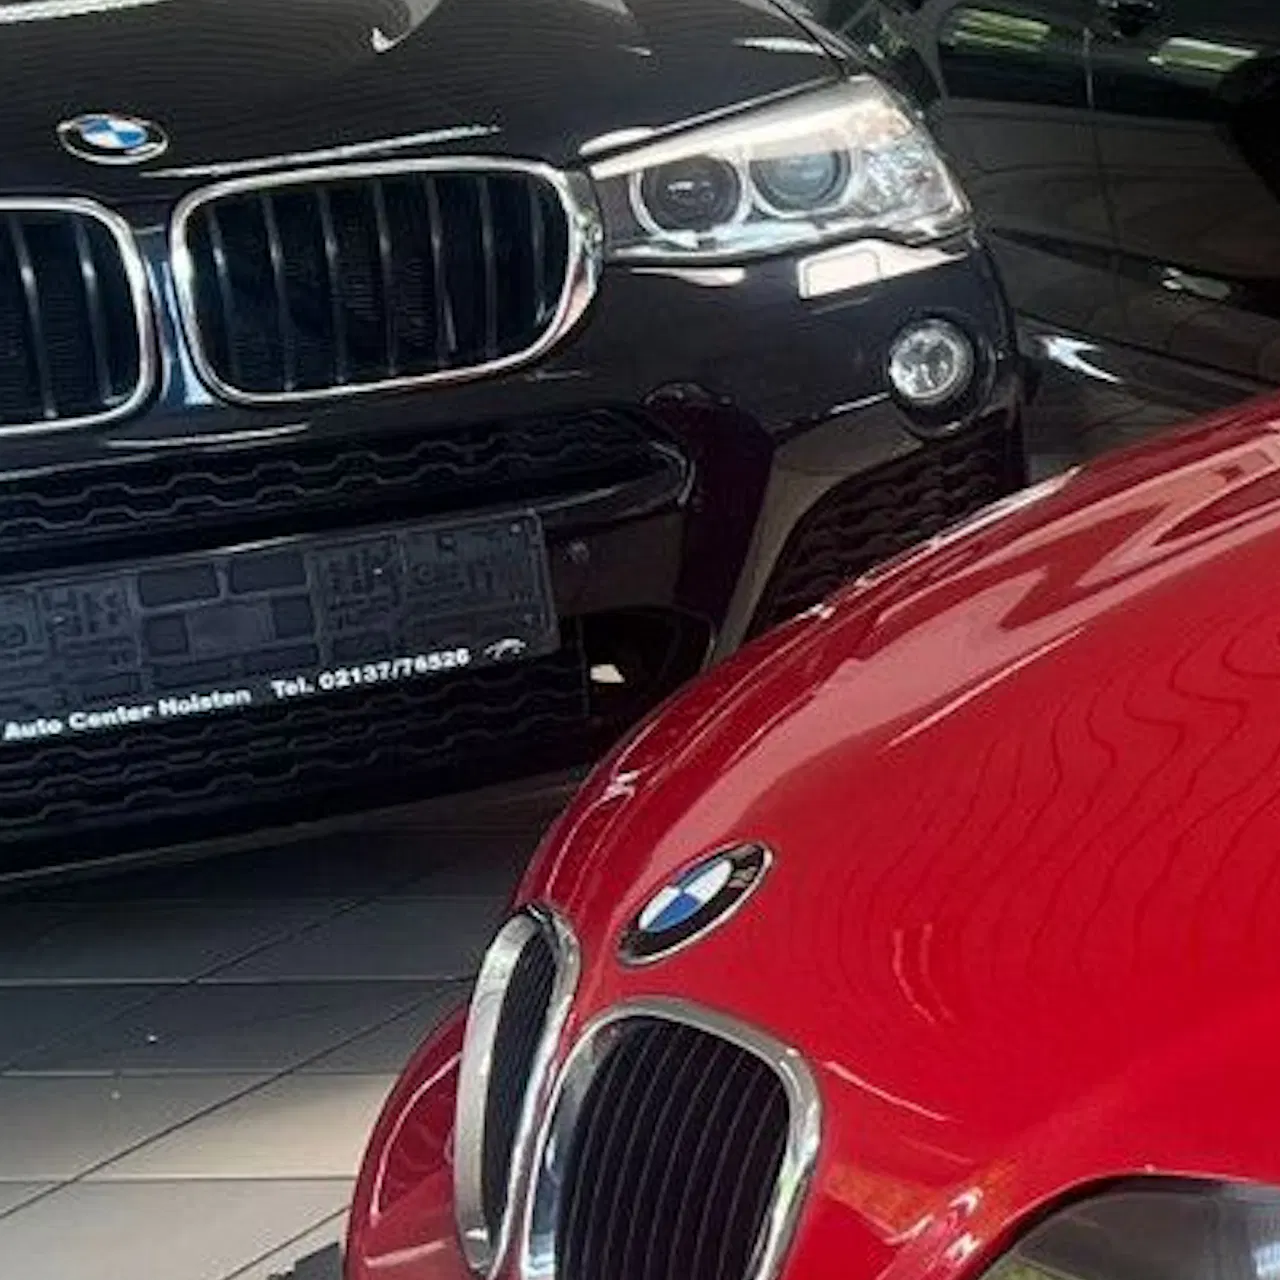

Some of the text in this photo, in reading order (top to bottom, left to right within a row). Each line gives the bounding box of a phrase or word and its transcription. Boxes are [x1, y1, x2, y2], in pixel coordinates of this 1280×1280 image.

[4, 718, 63, 741] Auto
[68, 705, 155, 729] Center
[270, 676, 315, 699] Tel.
